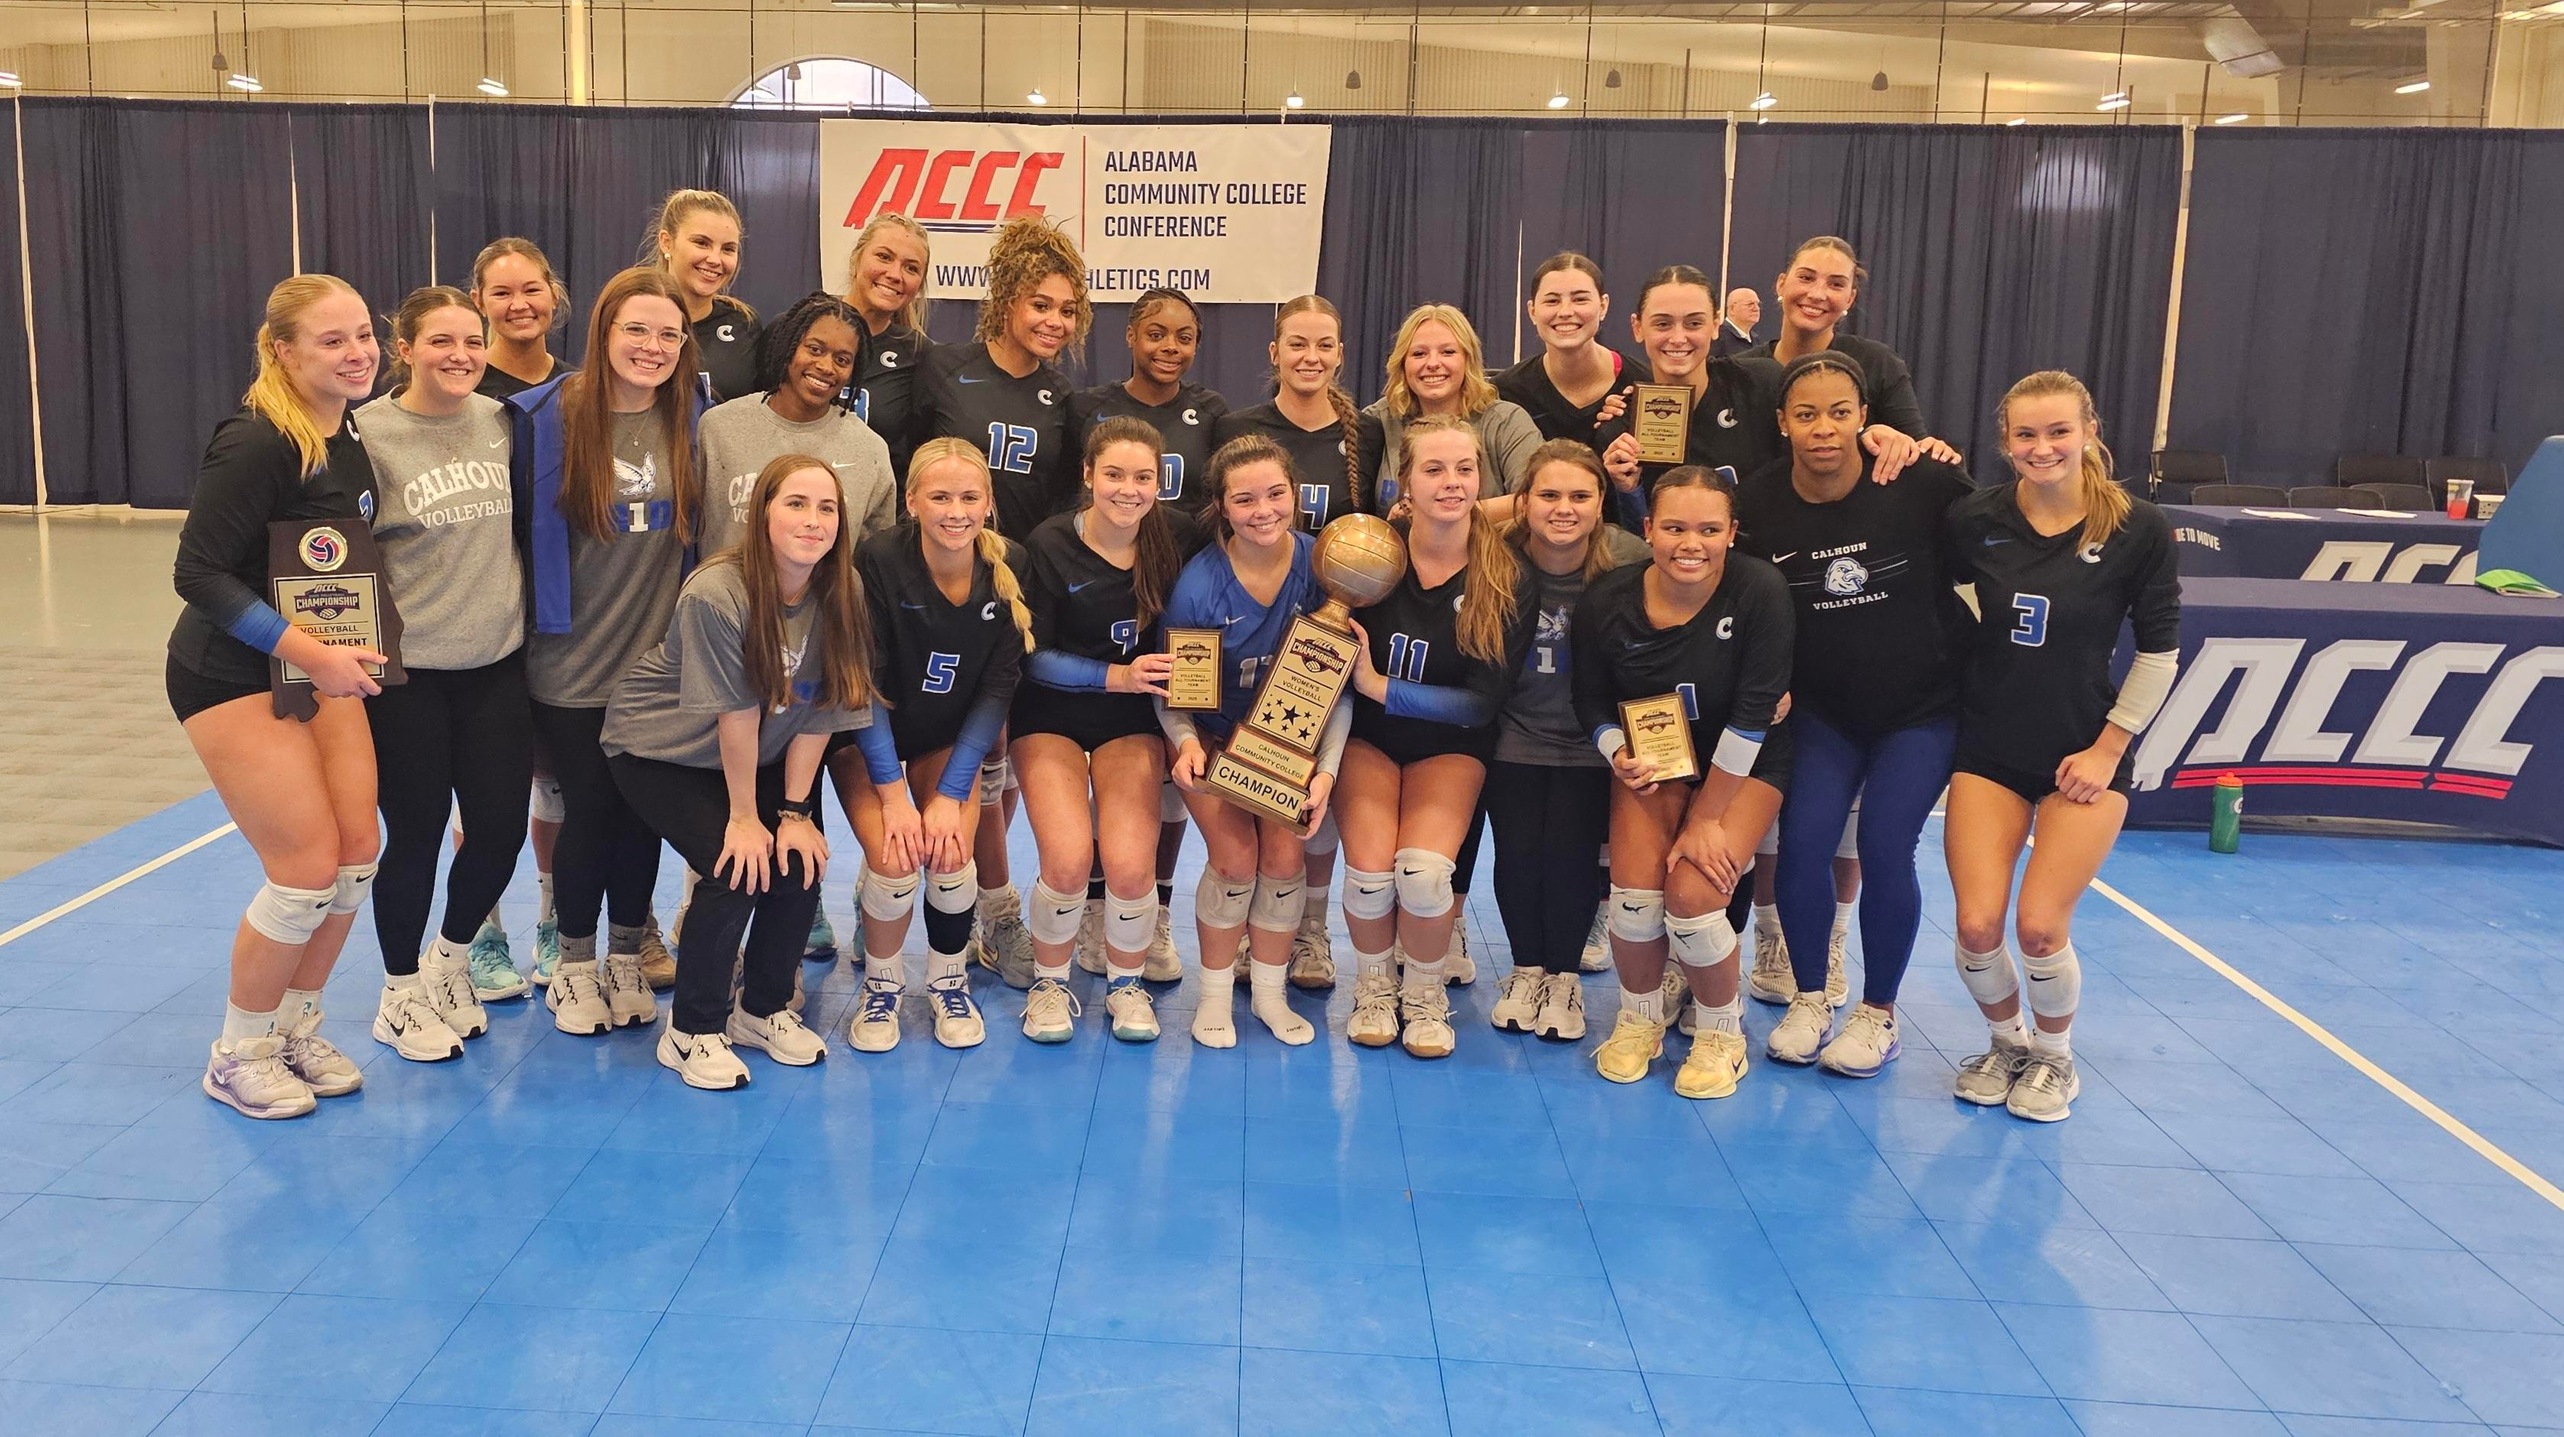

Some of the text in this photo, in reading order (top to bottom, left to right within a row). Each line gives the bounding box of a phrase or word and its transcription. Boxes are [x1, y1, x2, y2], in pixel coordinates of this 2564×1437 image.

[1105, 150, 1198, 173] ALABAMA
[843, 148, 1064, 230] ACCC
[1105, 183, 1307, 206] COMMUNITY COLLEGE
[1104, 216, 1227, 238] CONFERENCE
[987, 421, 1038, 474] 12
[417, 498, 512, 529] VOLLEYBAL
[1811, 542, 1867, 559] CALHOUN
[2196, 529, 2221, 551] MOVE
[296, 596, 358, 609] CHAMPIONSHIP
[1813, 591, 1889, 610] VOLLEYBALL
[300, 625, 358, 634] VOLLEYBALL
[2011, 592, 2050, 647] 3
[319, 638, 367, 646] NAMENT
[1111, 619, 1138, 655] 9
[1292, 642, 1343, 670] CHAMPIONSHIP
[1387, 632, 1429, 683] 11
[922, 651, 960, 694] 5
[1291, 675, 1320, 692] WOMEN'S
[1282, 680, 1322, 701] VOLLEYBALL
[2131, 637, 2564, 792] ACCC
[1235, 744, 1304, 780] COMMUNITY COLLEGE
[1259, 744, 1290, 762] CALHOUN
[1219, 766, 1299, 810] CHAMPION
